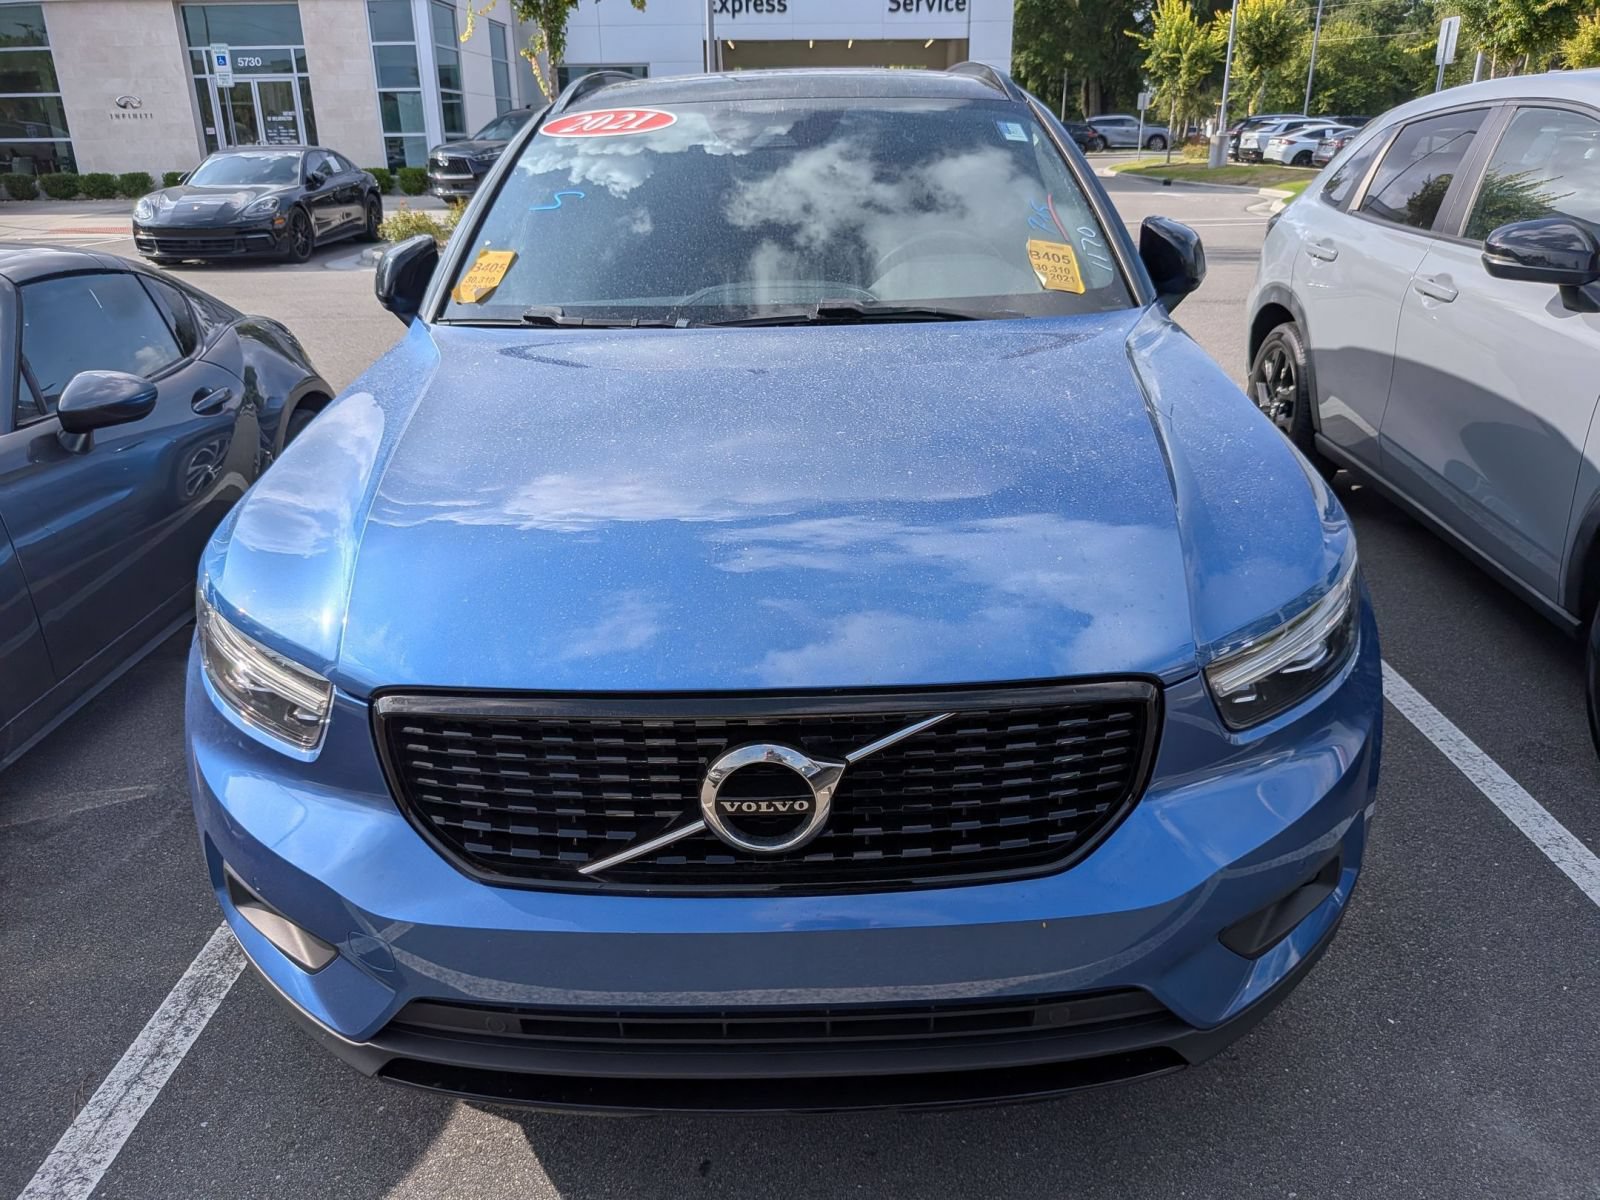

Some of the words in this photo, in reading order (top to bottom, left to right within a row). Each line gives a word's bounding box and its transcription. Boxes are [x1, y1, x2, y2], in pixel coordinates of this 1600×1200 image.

[713, 0, 788, 19] xpress
[888, 0, 966, 13] Service
[237, 57, 262, 67] 5730
[557, 112, 659, 133] 2021
[1030, 250, 1071, 265] B405
[1049, 273, 1075, 283] 2021
[720, 800, 809, 812] VOLVO
